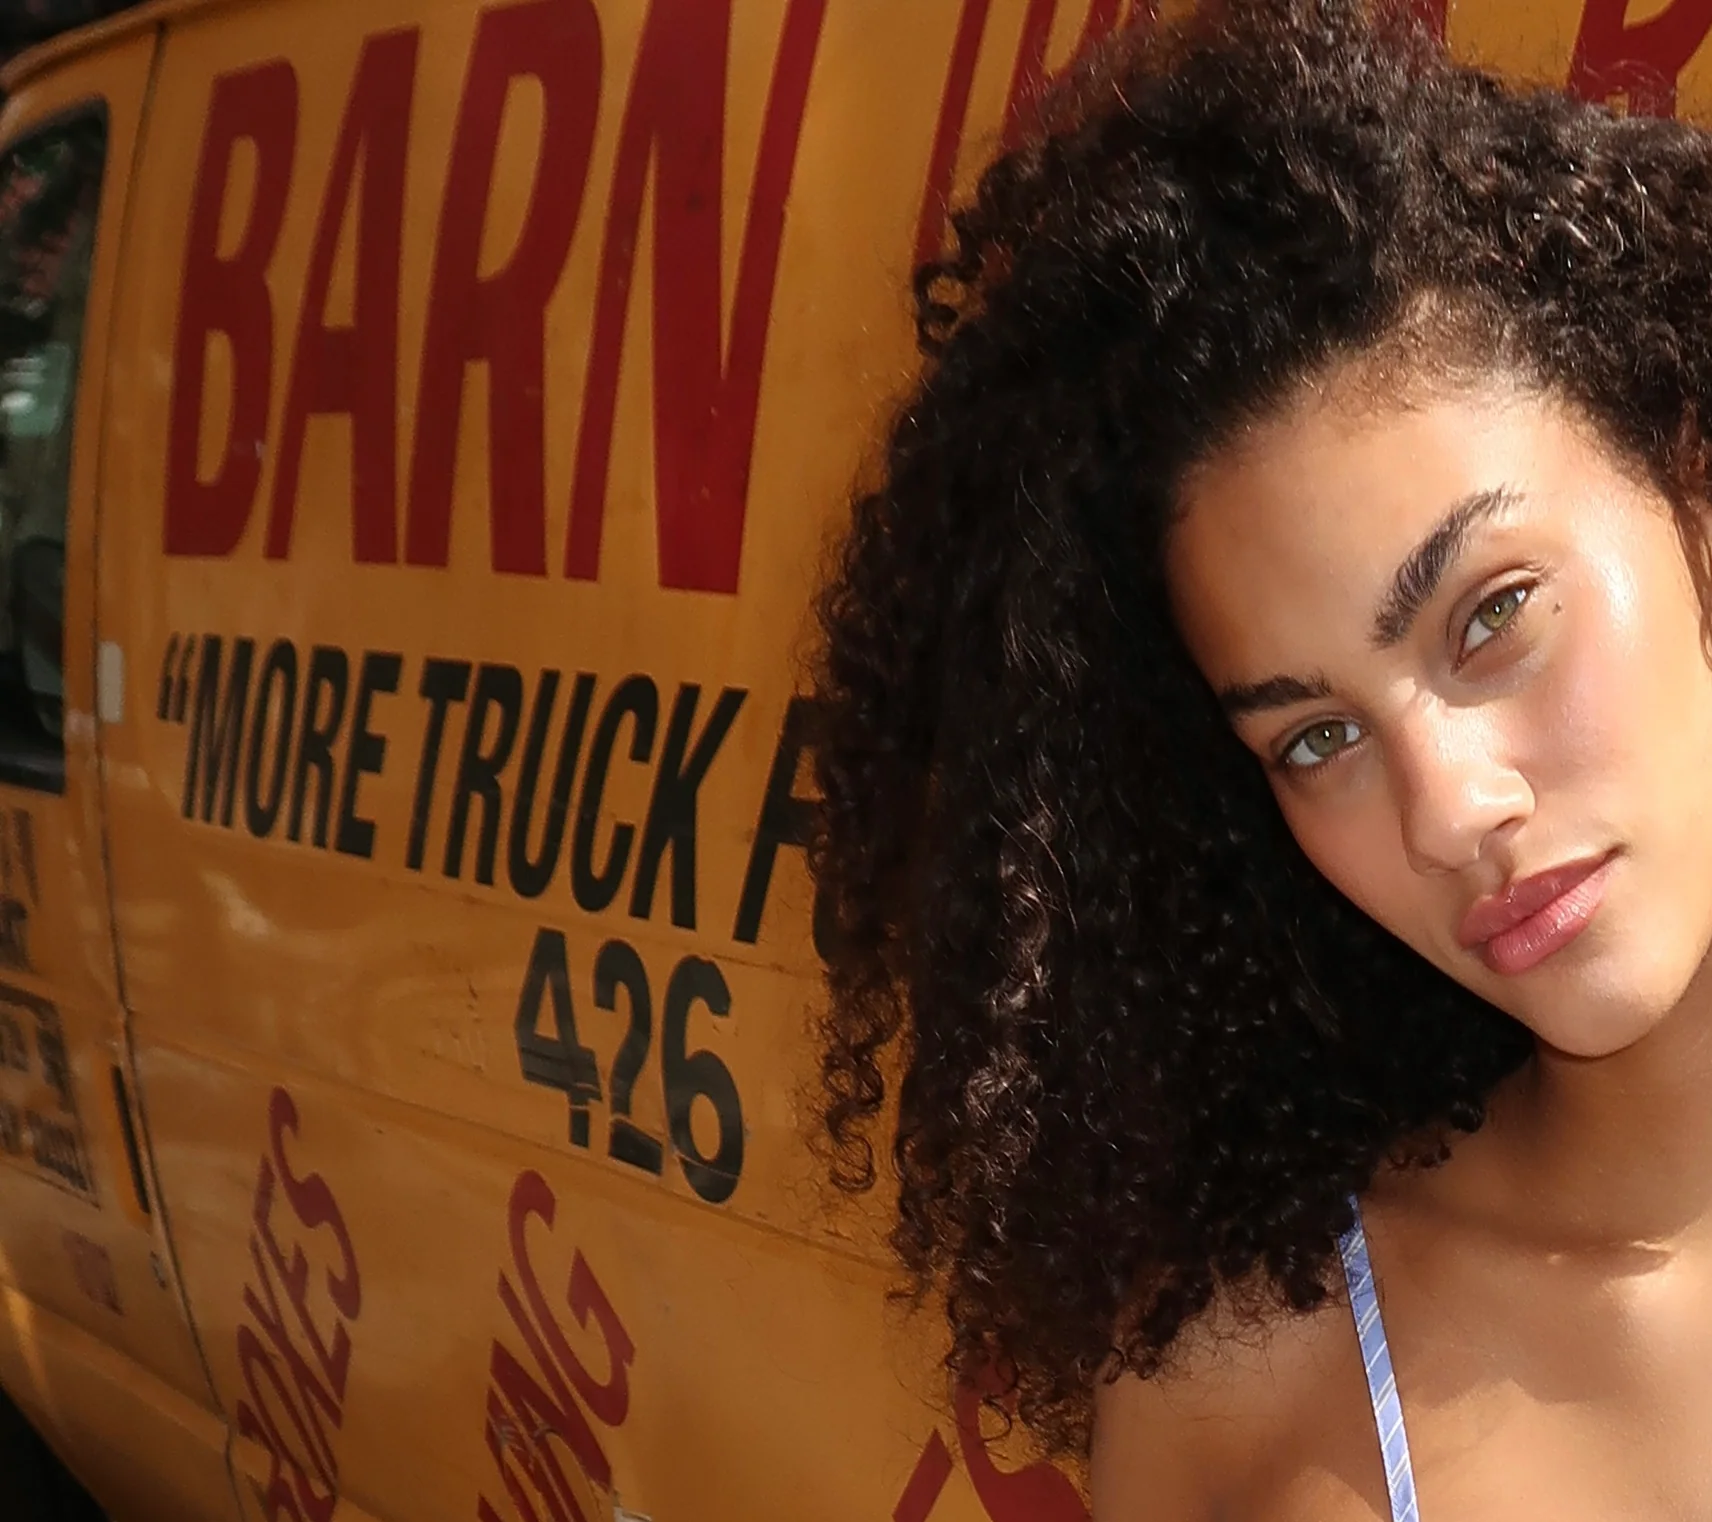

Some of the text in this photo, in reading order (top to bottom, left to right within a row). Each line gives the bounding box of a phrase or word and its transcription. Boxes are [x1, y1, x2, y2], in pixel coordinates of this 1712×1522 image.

[162, 0, 827, 596] BARN
[406, 657, 748, 931] TRUCK
[513, 926, 745, 1205] 426
